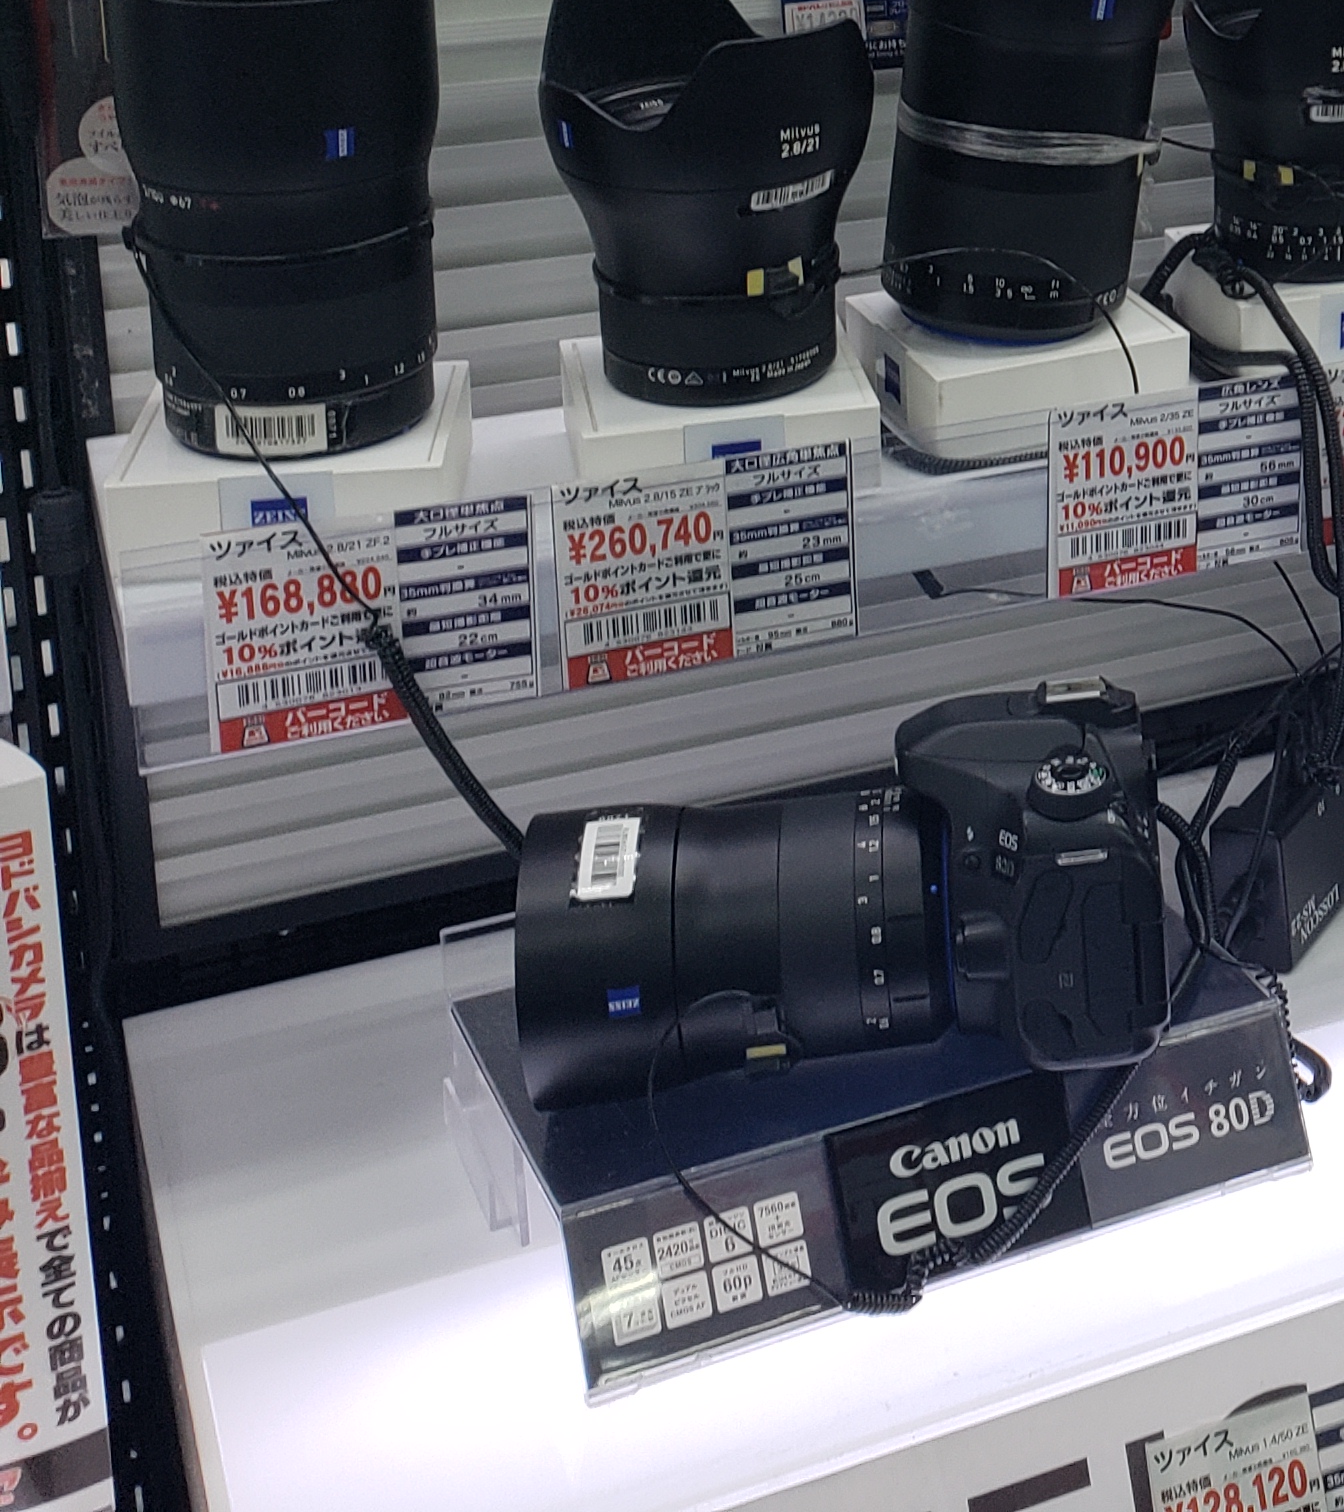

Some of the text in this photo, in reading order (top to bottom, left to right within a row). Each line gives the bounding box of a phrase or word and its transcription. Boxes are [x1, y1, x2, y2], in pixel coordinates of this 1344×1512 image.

[779, 123, 821, 143] Milvus
[1057, 401, 1128, 427] ツァイス
[753, 465, 821, 486] フルサイズ
[560, 477, 643, 504] ツァイス
[423, 518, 498, 540] フルサイズ
[209, 531, 303, 561] ツァイス
[998, 830, 1019, 852] EOS
[1102, 1088, 1276, 1172] EOS 80D
[888, 1117, 1021, 1179] Canon
[875, 1153, 1047, 1258] EOS
[1153, 1428, 1233, 1473] ツァイス
